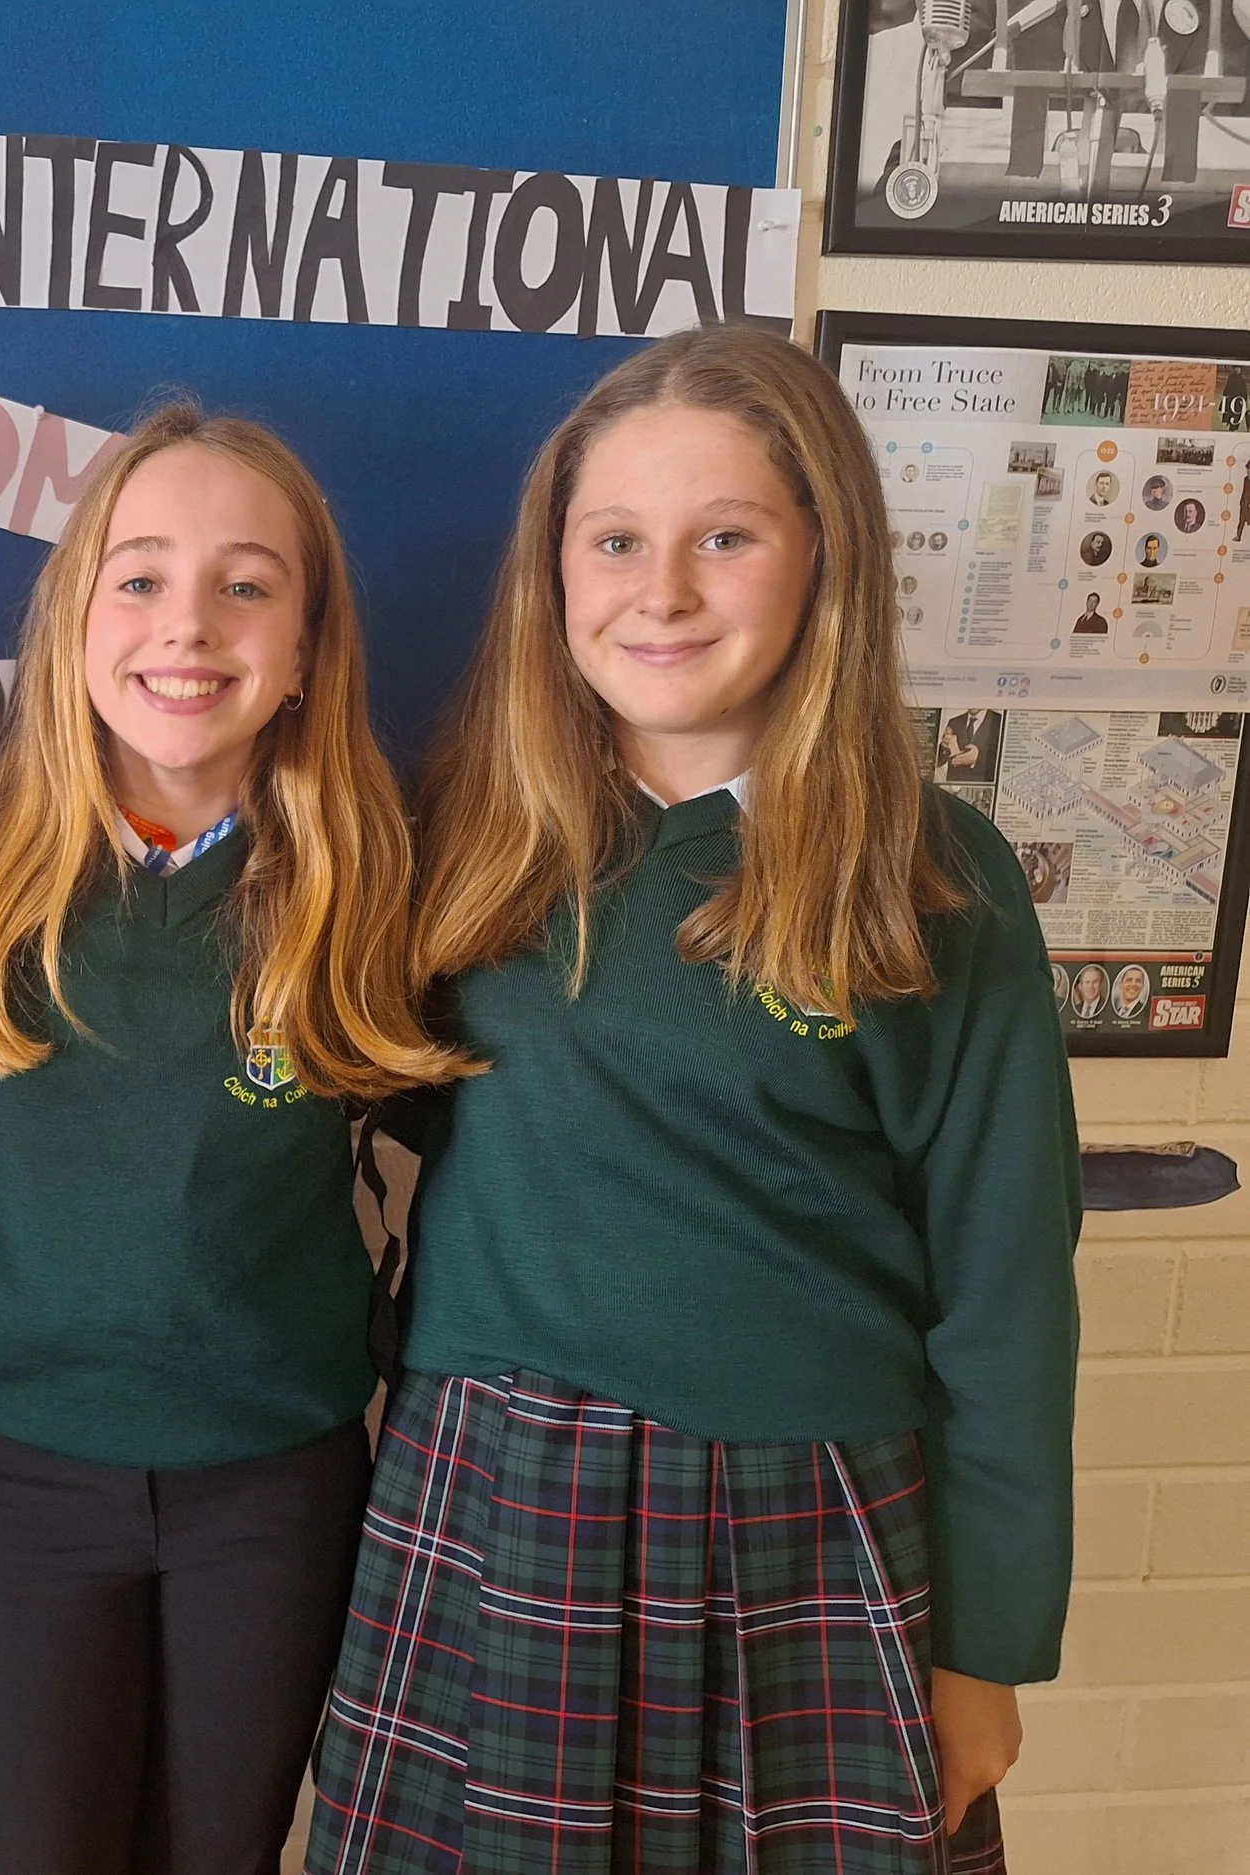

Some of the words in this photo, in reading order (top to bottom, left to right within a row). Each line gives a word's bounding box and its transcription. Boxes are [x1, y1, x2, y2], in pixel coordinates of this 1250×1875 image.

[998, 200, 1089, 225] AMERICAN
[1091, 202, 1150, 227] SERIES
[1151, 194, 1174, 228] 3
[857, 359, 923, 384] From
[931, 360, 1004, 385] Truce
[855, 391, 876, 411] to
[885, 388, 942, 412] Free
[950, 388, 1017, 413] State
[1153, 392, 1250, 426] 1921-19
[1159, 965, 1206, 978] AMERICAN
[1161, 976, 1191, 989] SERIES
[756, 983, 789, 1022] Cloich
[789, 1019, 809, 1037] na
[1152, 999, 1202, 1028] STAR
[223, 1076, 257, 1106] Cloich
[262, 1097, 278, 1109] na
